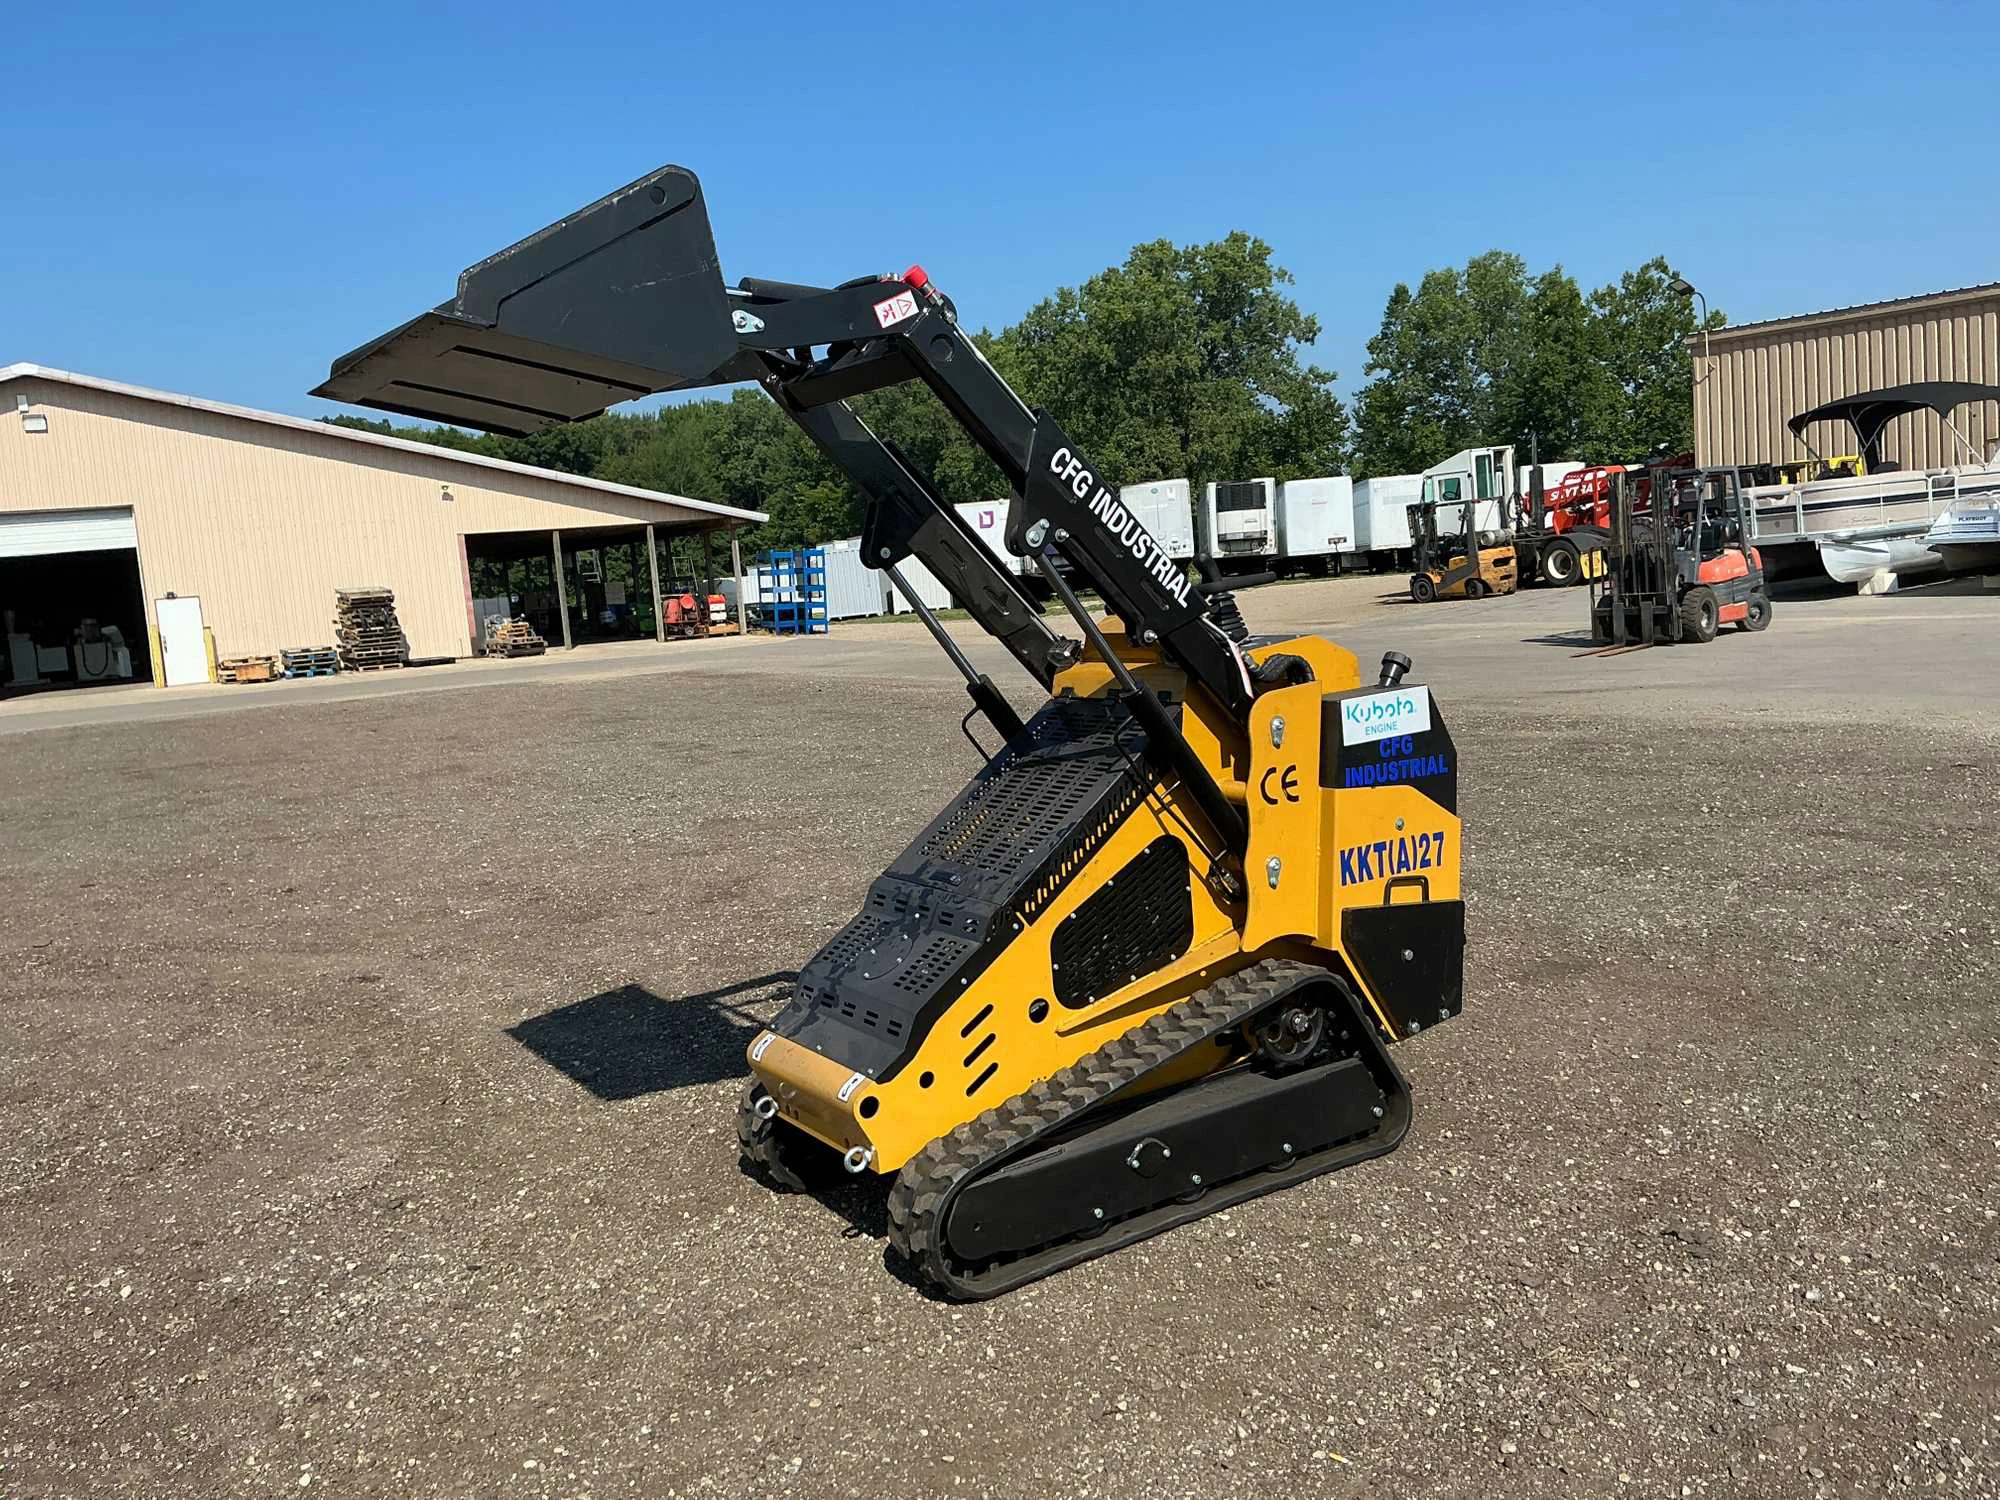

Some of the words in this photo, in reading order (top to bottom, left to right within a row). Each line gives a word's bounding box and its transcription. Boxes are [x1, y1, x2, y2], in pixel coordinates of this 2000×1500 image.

[1050, 447, 1094, 499] CFG
[1088, 486, 1192, 609] INDUSTRIAL
[1346, 696, 1414, 723] Kubota
[1365, 721, 1398, 736] ENGINE
[1379, 735, 1414, 758] CFG
[1260, 764, 1300, 805] CE
[1345, 753, 1449, 788] INDUSTRIAL
[1340, 831, 1445, 887] KKT(A)27
